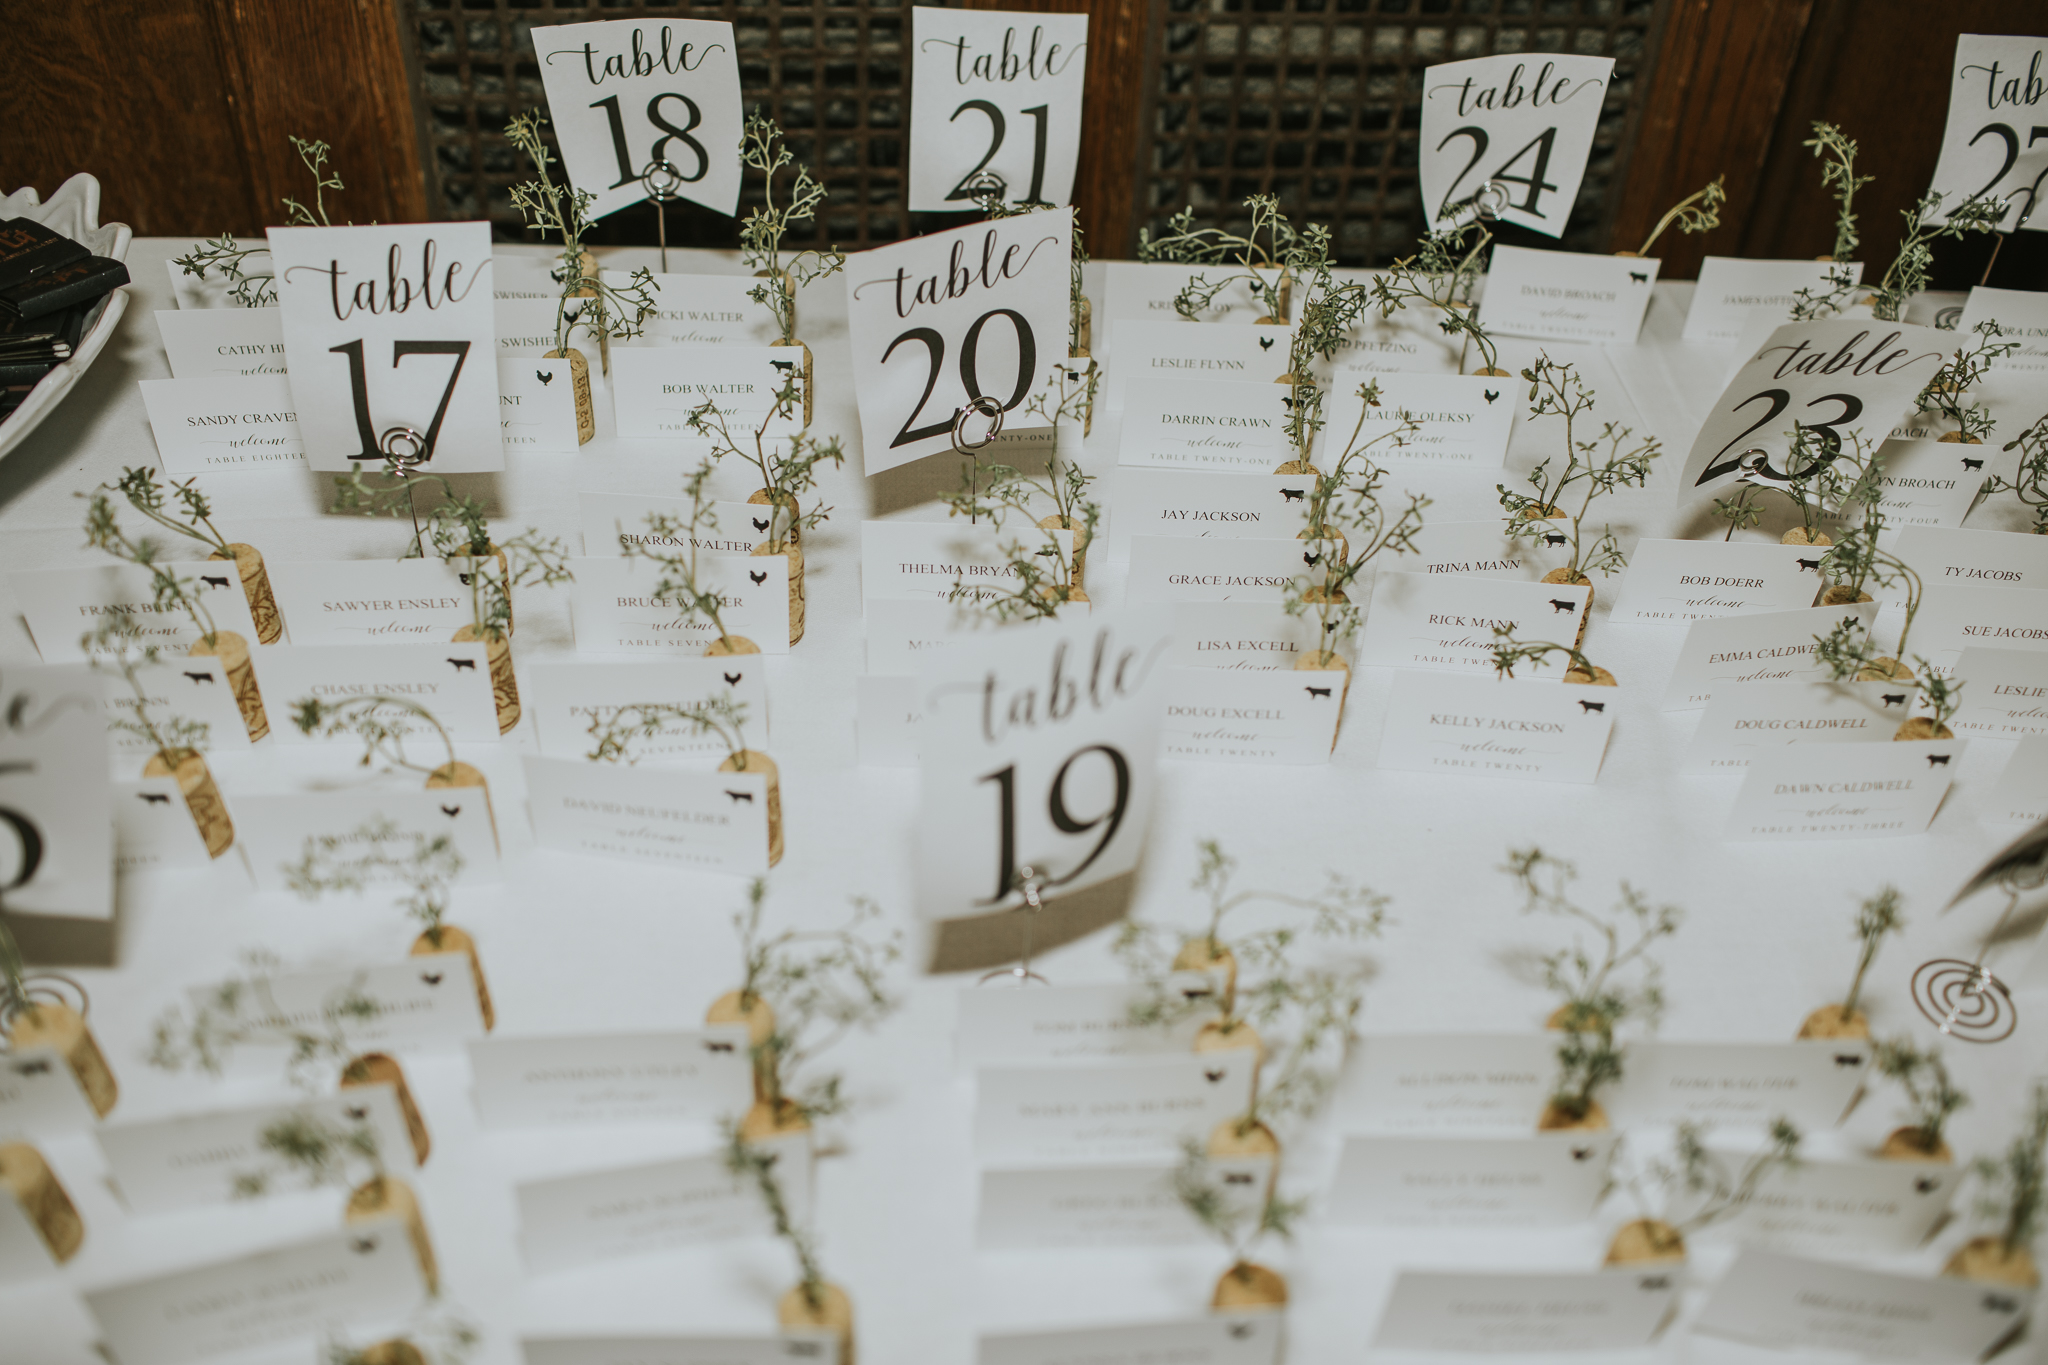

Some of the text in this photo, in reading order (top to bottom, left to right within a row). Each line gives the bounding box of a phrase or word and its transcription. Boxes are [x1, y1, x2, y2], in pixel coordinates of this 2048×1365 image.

[547, 25, 725, 85] table
[921, 25, 1087, 85] table
[1961, 49, 2048, 110] tab
[1428, 61, 1603, 117] table
[589, 92, 709, 190] 18
[944, 99, 1056, 206] 21
[1436, 126, 1558, 223] 24
[285, 239, 493, 321] table
[853, 229, 1058, 318] table
[688, 310, 744, 323] WALTER
[217, 343, 266, 356] CATHY
[1758, 330, 1942, 379] table
[236, 362, 288, 376] welcom
[1151, 357, 1245, 370] LESLIE FLYNN
[880, 308, 1037, 449] 20
[662, 383, 755, 394] BOB WALTER
[328, 338, 471, 462] 17
[187, 414, 238, 427] SANDY
[1161, 413, 1272, 428] DARRIN CRAWN
[1366, 410, 1475, 423] LAURE OLEKSY
[986, 433, 1053, 443] ENTY-ONE
[1694, 388, 1863, 488] 23
[205, 452, 307, 464] TABLE EIGHTEE
[1150, 452, 1273, 466] TABLE TWENTY-ONE
[1361, 450, 1474, 461] ABLE TWENTY-ONE
[1898, 477, 1957, 489] BROACH
[1160, 509, 1261, 522] JAY JACKSON
[619, 533, 753, 552] SHARON WALTER
[898, 562, 964, 575] THELMA
[1426, 558, 1521, 574] TRINA MANN
[1944, 565, 2023, 582] TY JACOBS
[1168, 574, 1297, 588] GRACE JACKSON
[1680, 574, 1765, 589] BOB DOERR
[79, 602, 138, 616] FRANK
[322, 597, 461, 612] SAWYER ENSLEY
[617, 596, 672, 608] BRUCE
[1428, 613, 1520, 630] RICK MANN
[1636, 611, 1676, 620] TABLE
[1962, 625, 2048, 640] SUE JACOBS
[135, 643, 190, 652] SEVENT
[617, 639, 712, 647] TABLE SEVEN
[1197, 640, 1299, 652] LISA EXCELL
[1413, 654, 1456, 664] TABLE
[1709, 650, 1753, 664] EMMA
[310, 682, 440, 697] CHASE ENSLEY
[932, 627, 1172, 744] table
[1993, 684, 2048, 698] LESLIE
[1688, 693, 1713, 703] TAB
[1167, 705, 1286, 720] DOUG EXCELL
[1430, 713, 1566, 734] KELLY JACKSON
[1734, 718, 1869, 731] DOUG CALDWELL
[1953, 721, 2048, 734] TABLE TWENT
[1167, 745, 1277, 757] TABLE TWENTY
[1432, 757, 1543, 773] TABLE TWENTY
[1773, 779, 1915, 796] DAWN CALDWELL
[975, 745, 1131, 908] 19
